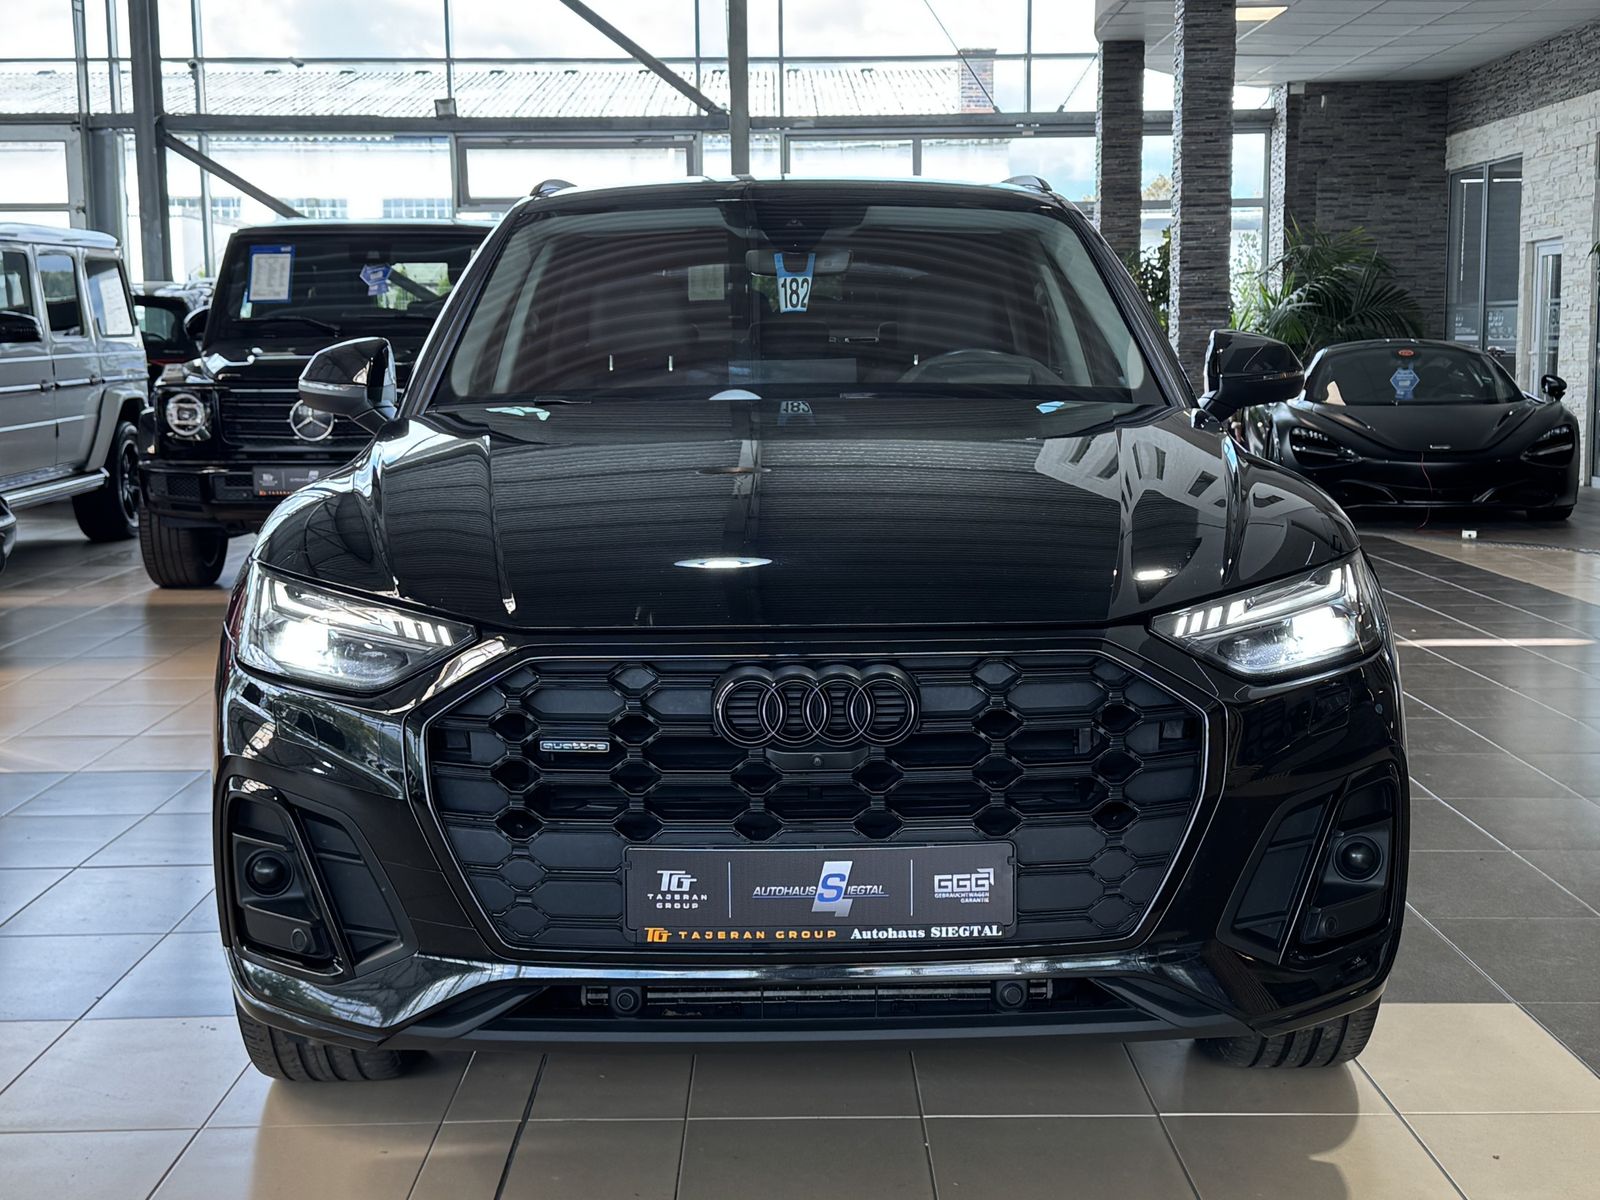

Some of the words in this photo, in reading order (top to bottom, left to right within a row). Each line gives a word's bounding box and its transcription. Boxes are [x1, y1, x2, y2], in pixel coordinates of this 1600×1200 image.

[781, 277, 811, 309] 182
[543, 742, 607, 750] quattro
[752, 885, 817, 896] AUTOHAUS
[816, 873, 885, 903] SIEGTAL
[934, 871, 990, 893] GGG
[647, 893, 708, 901] TAJERAN
[656, 902, 699, 910] GROUP
[679, 930, 766, 940] TAJERAN
[775, 930, 837, 940] GROUP
[850, 927, 926, 940] Autohaus
[930, 924, 1003, 938] SIEGTAL
